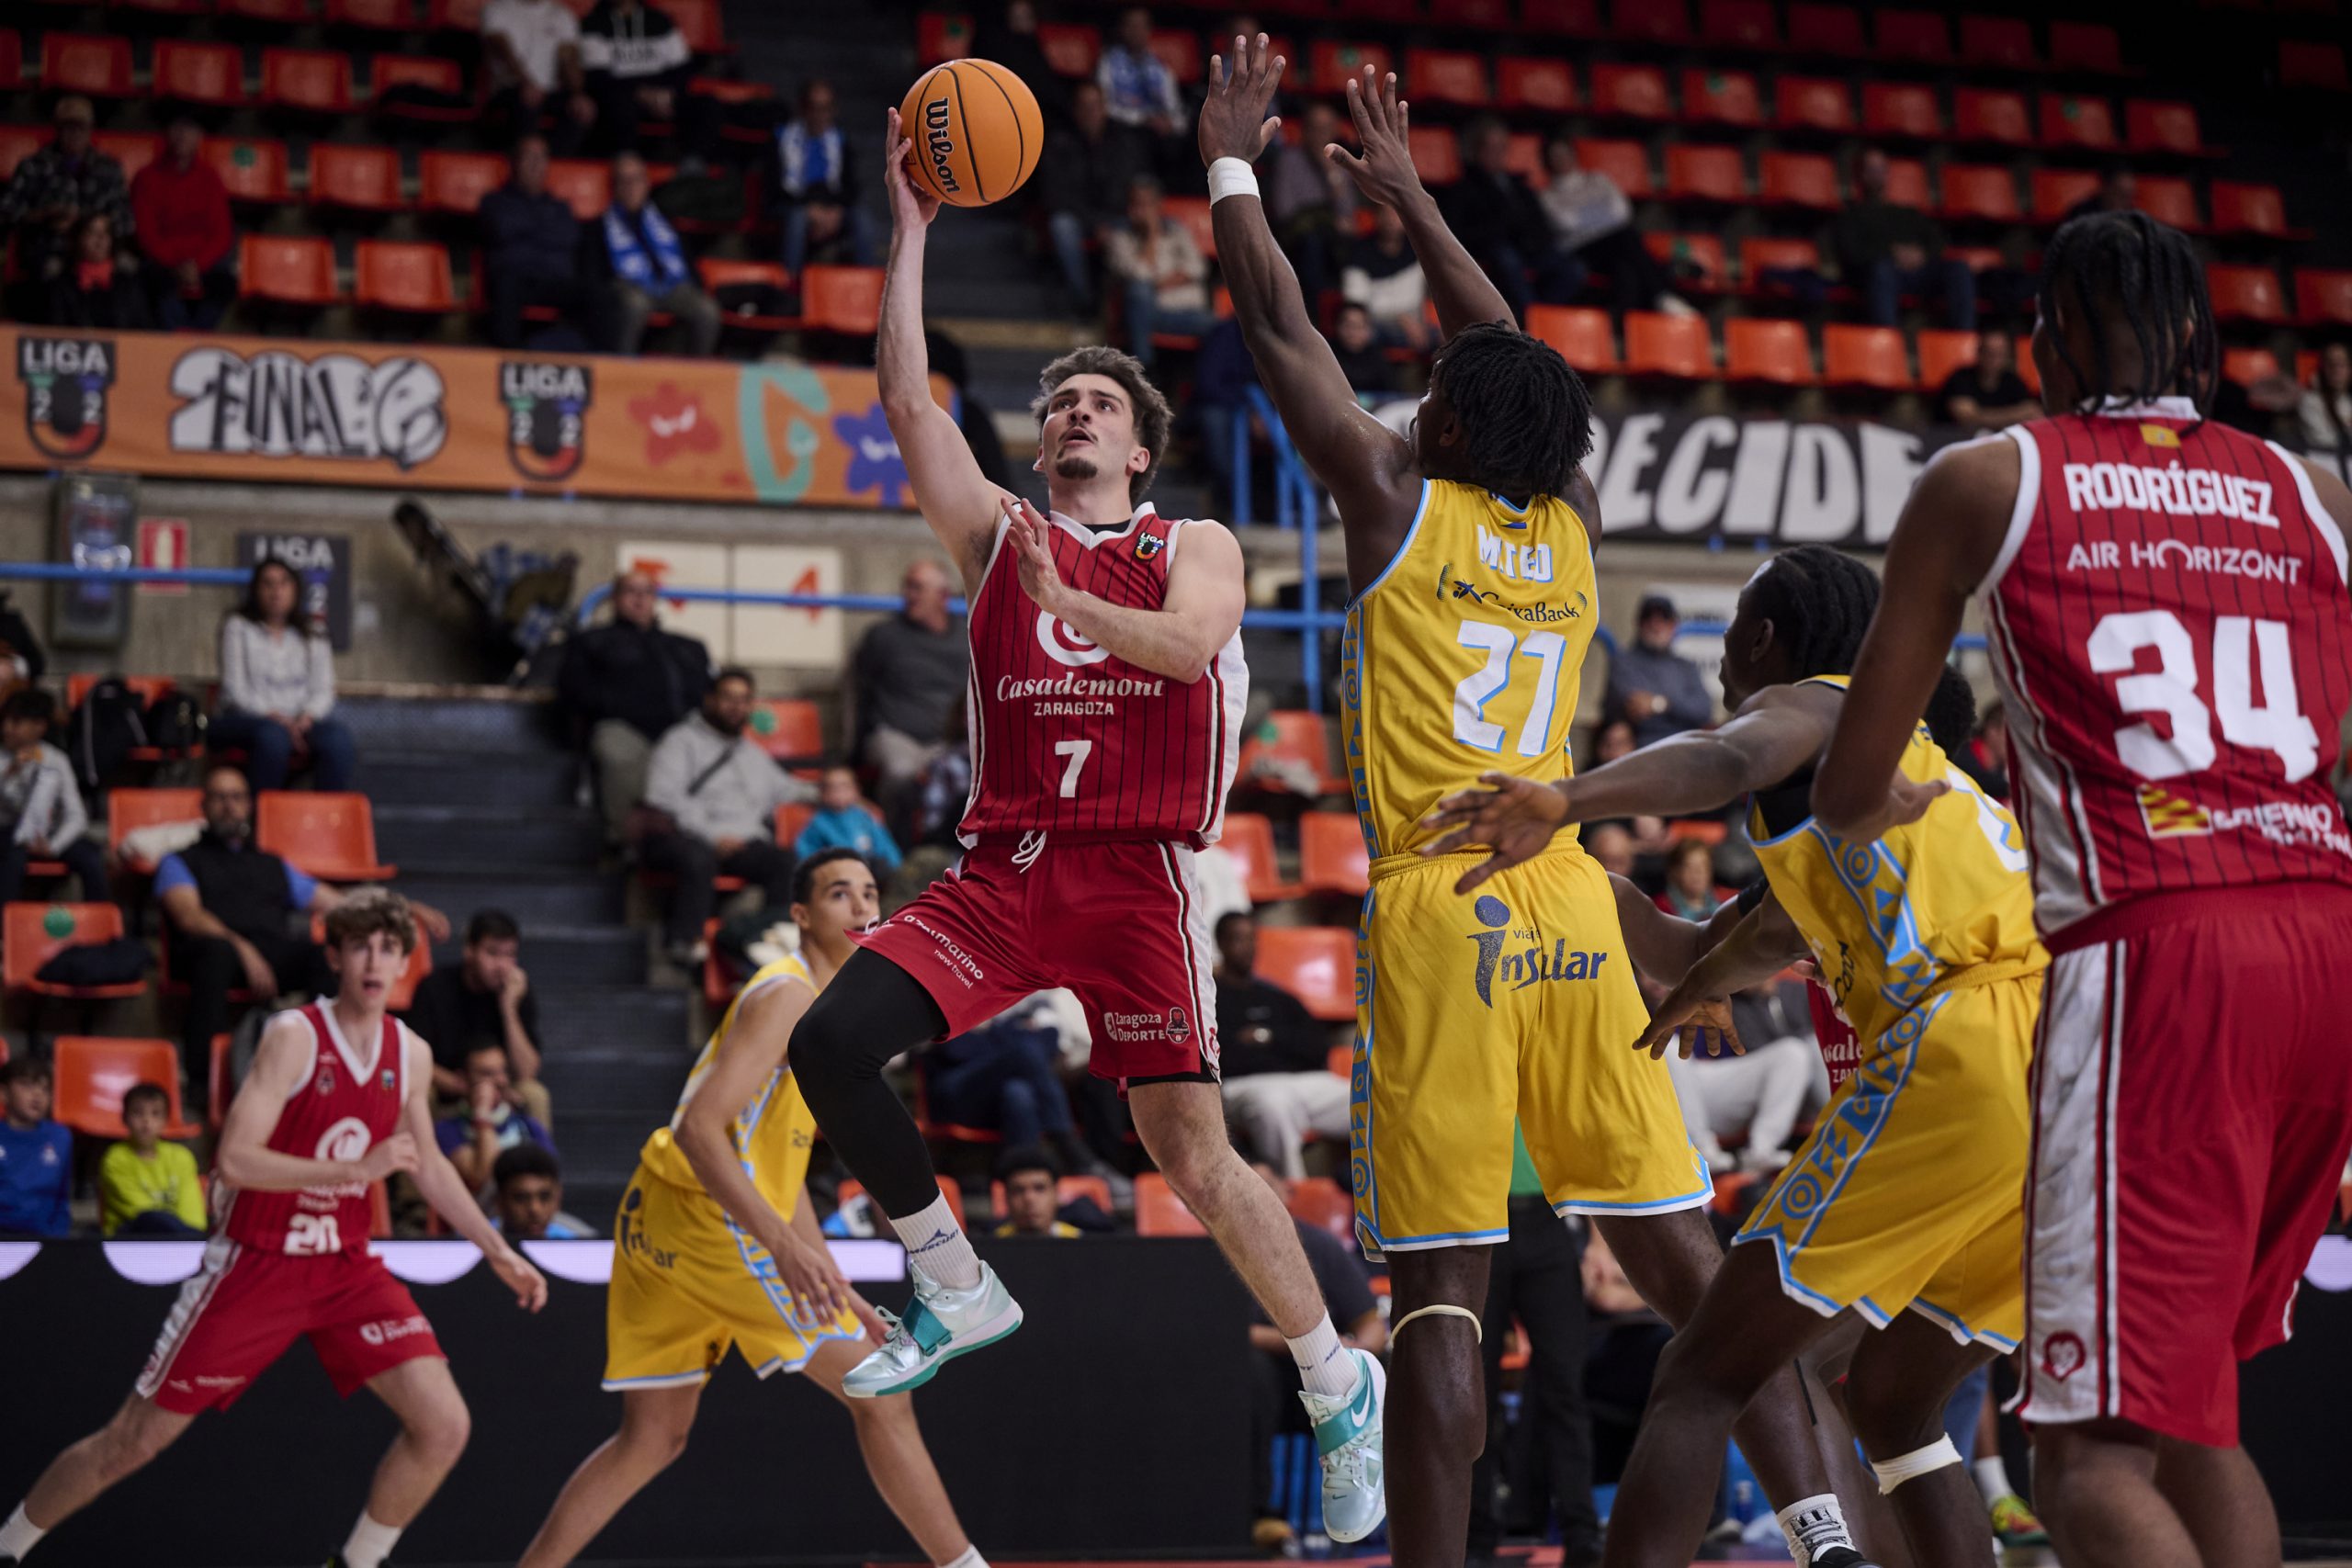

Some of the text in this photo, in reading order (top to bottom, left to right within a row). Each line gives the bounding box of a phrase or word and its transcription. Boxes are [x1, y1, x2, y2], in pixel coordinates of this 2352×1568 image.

[925, 96, 962, 193] Wilson
[24, 340, 108, 376] LIGA
[504, 362, 588, 399] LIGA
[2064, 458, 2280, 529] RODRÍGUEZ
[1140, 532, 1164, 547] LIGA
[2067, 538, 2302, 586] AIR HORIZONT
[996, 671, 1166, 702] Casademont
[2086, 609, 2321, 784] 34
[1034, 701, 1115, 716] ZARAGOZA
[1054, 739, 1093, 799] 7
[933, 948, 974, 990] new travel
[1114, 1011, 1163, 1029] Zaragoza
[1117, 1027, 1167, 1043] DEPORTE
